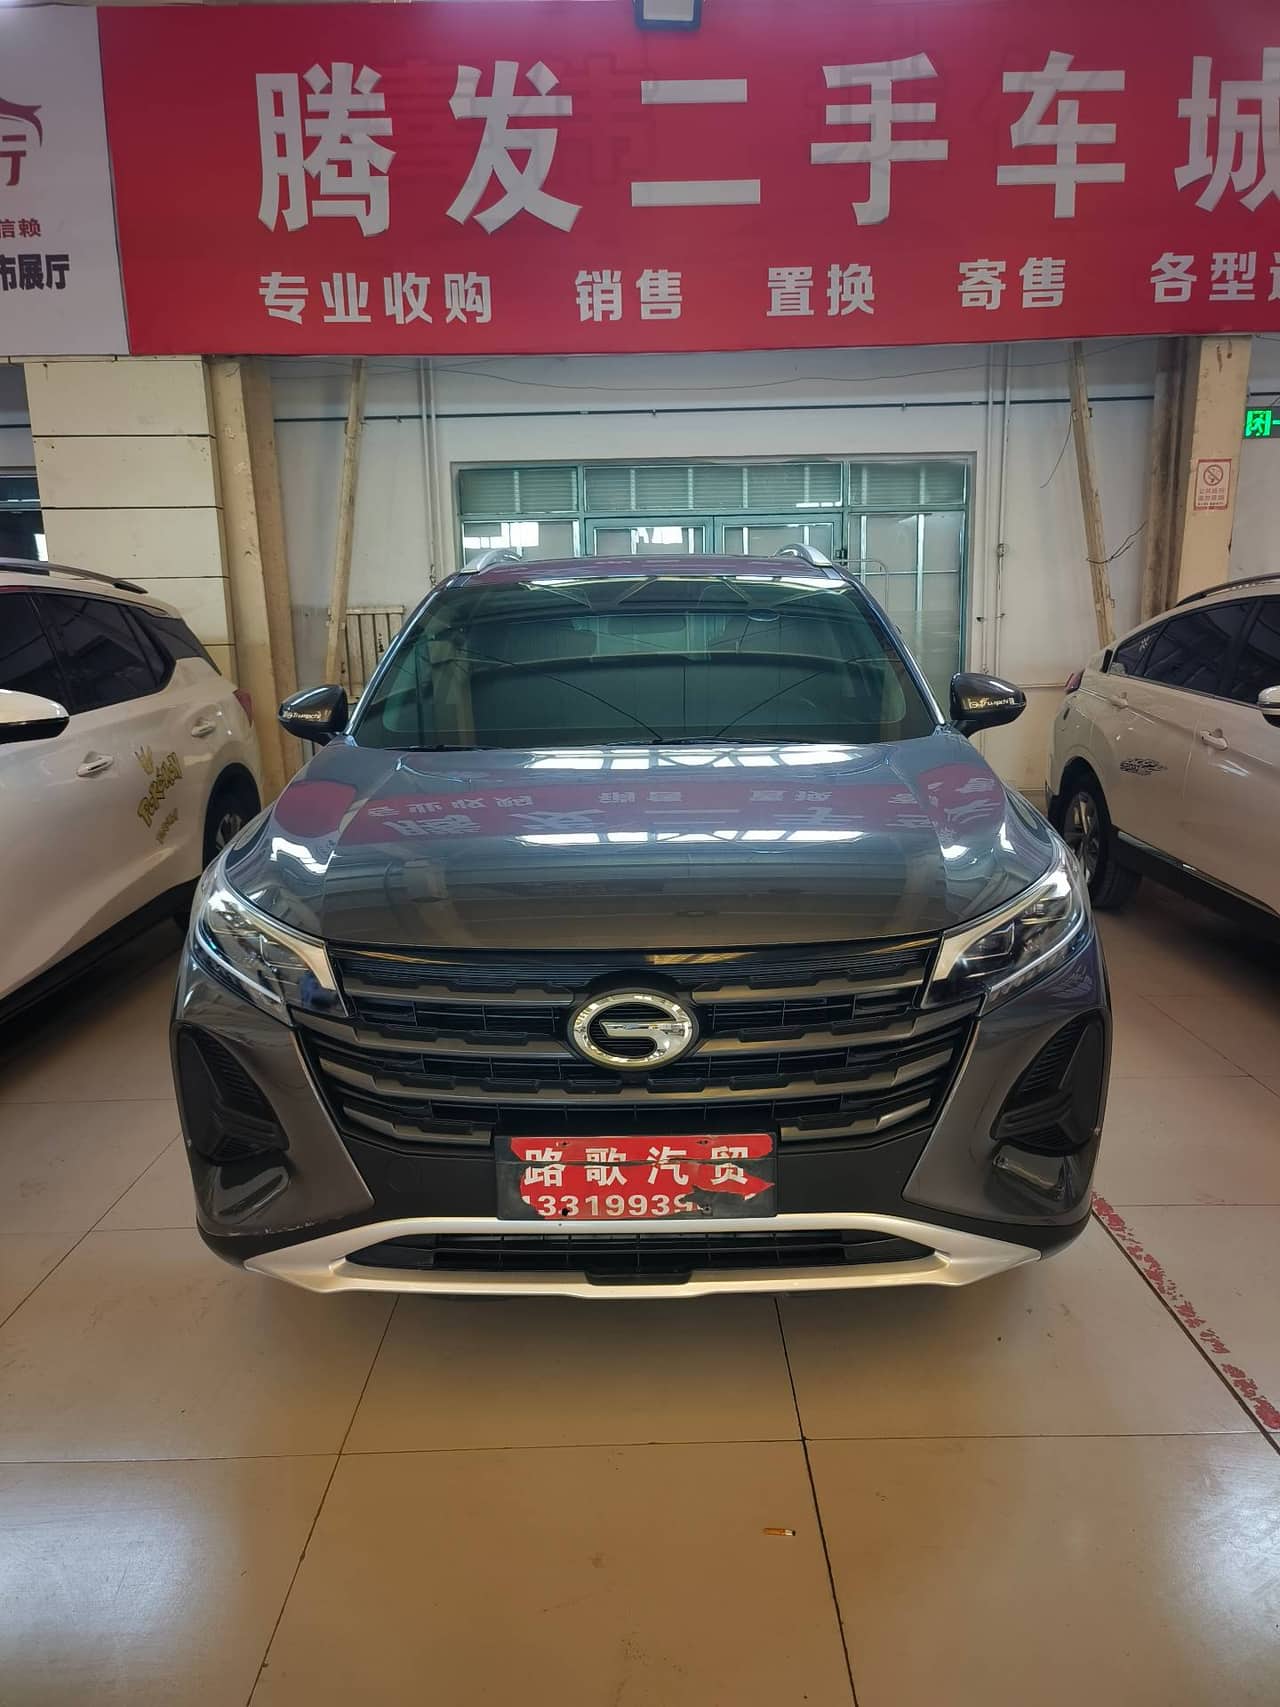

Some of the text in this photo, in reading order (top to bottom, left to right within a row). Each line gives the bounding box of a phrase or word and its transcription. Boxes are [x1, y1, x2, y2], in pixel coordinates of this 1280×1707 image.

[256, 48, 1280, 236] 腾发二手车城
[259, 252, 1280, 325] 专业收购 销售 置换 寄售 各型
[523, 1146, 749, 1187] 路歌汽贸
